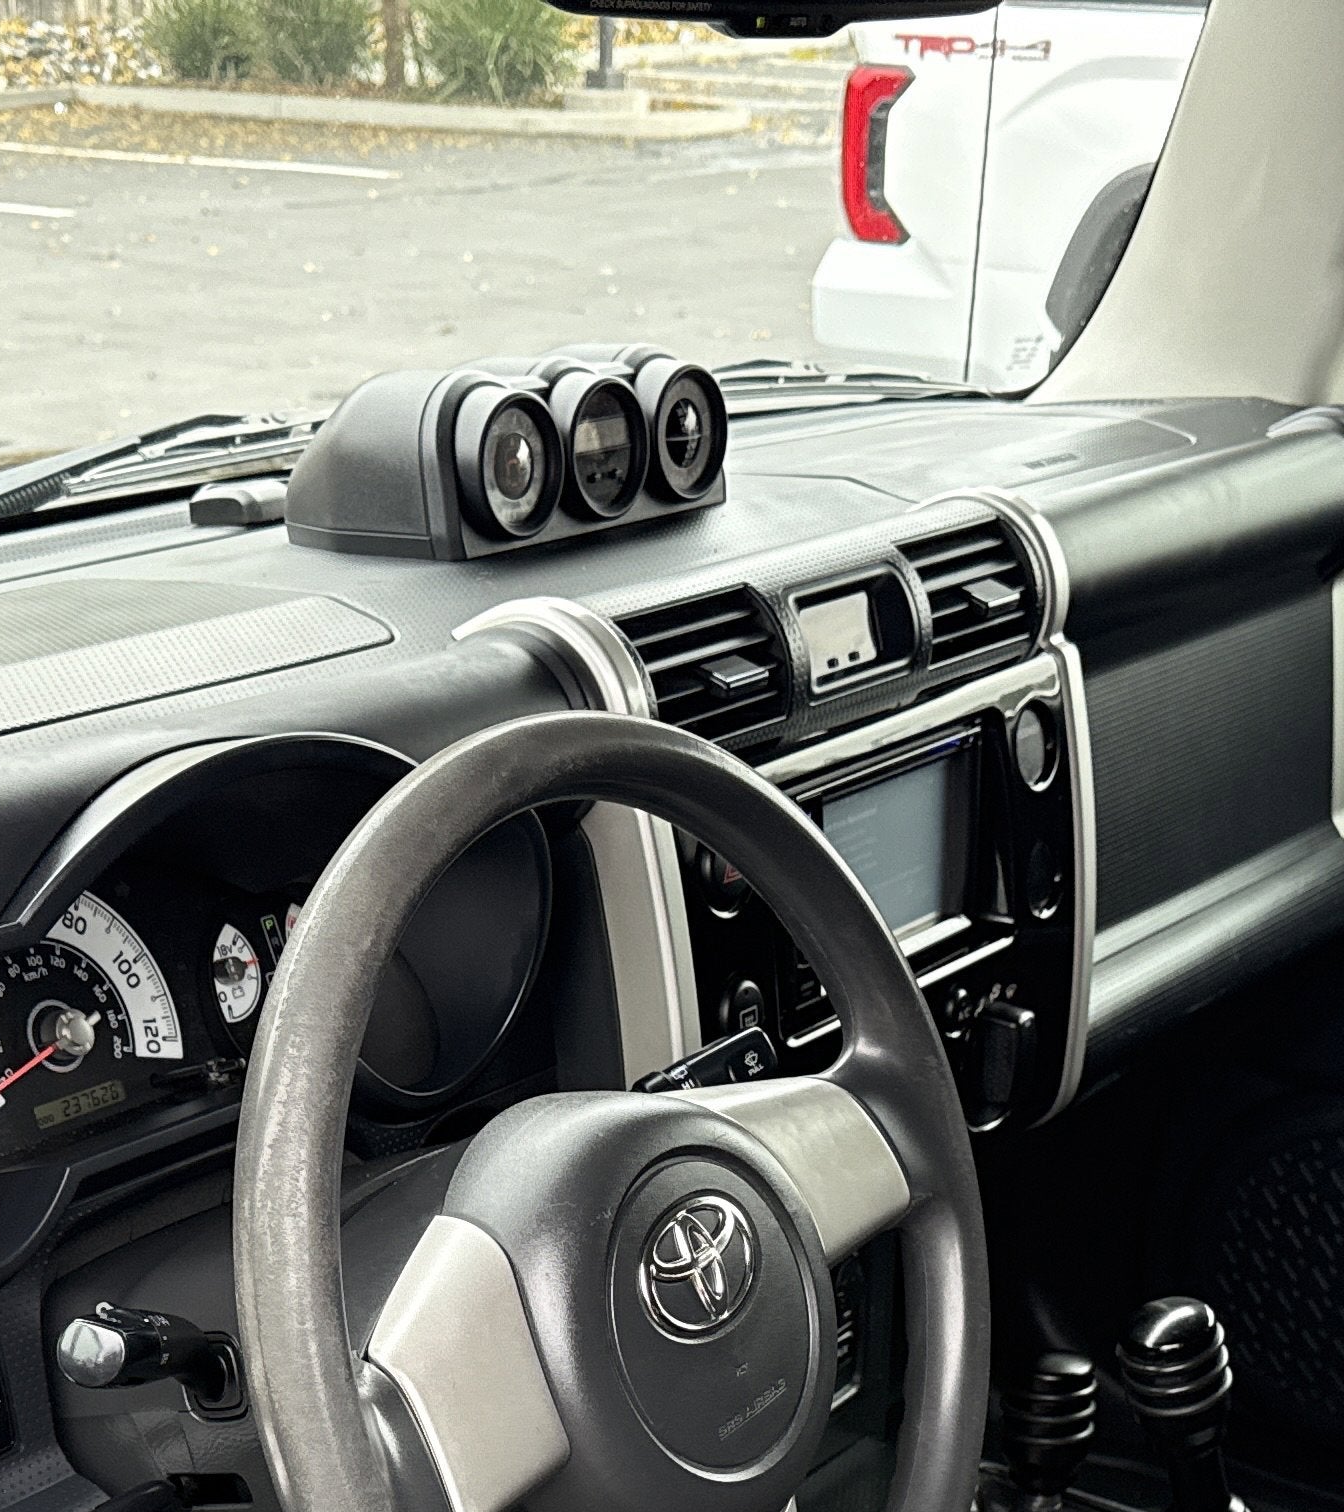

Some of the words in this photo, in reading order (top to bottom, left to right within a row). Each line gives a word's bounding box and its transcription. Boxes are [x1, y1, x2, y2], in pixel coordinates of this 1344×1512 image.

[894, 34, 976, 61] TRD
[61, 911, 87, 935] 80
[27, 955, 44, 966] 100
[50, 954, 66, 969] 120
[112, 949, 141, 989] 100
[22, 967, 49, 982] km/h
[142, 1017, 162, 1054] 120
